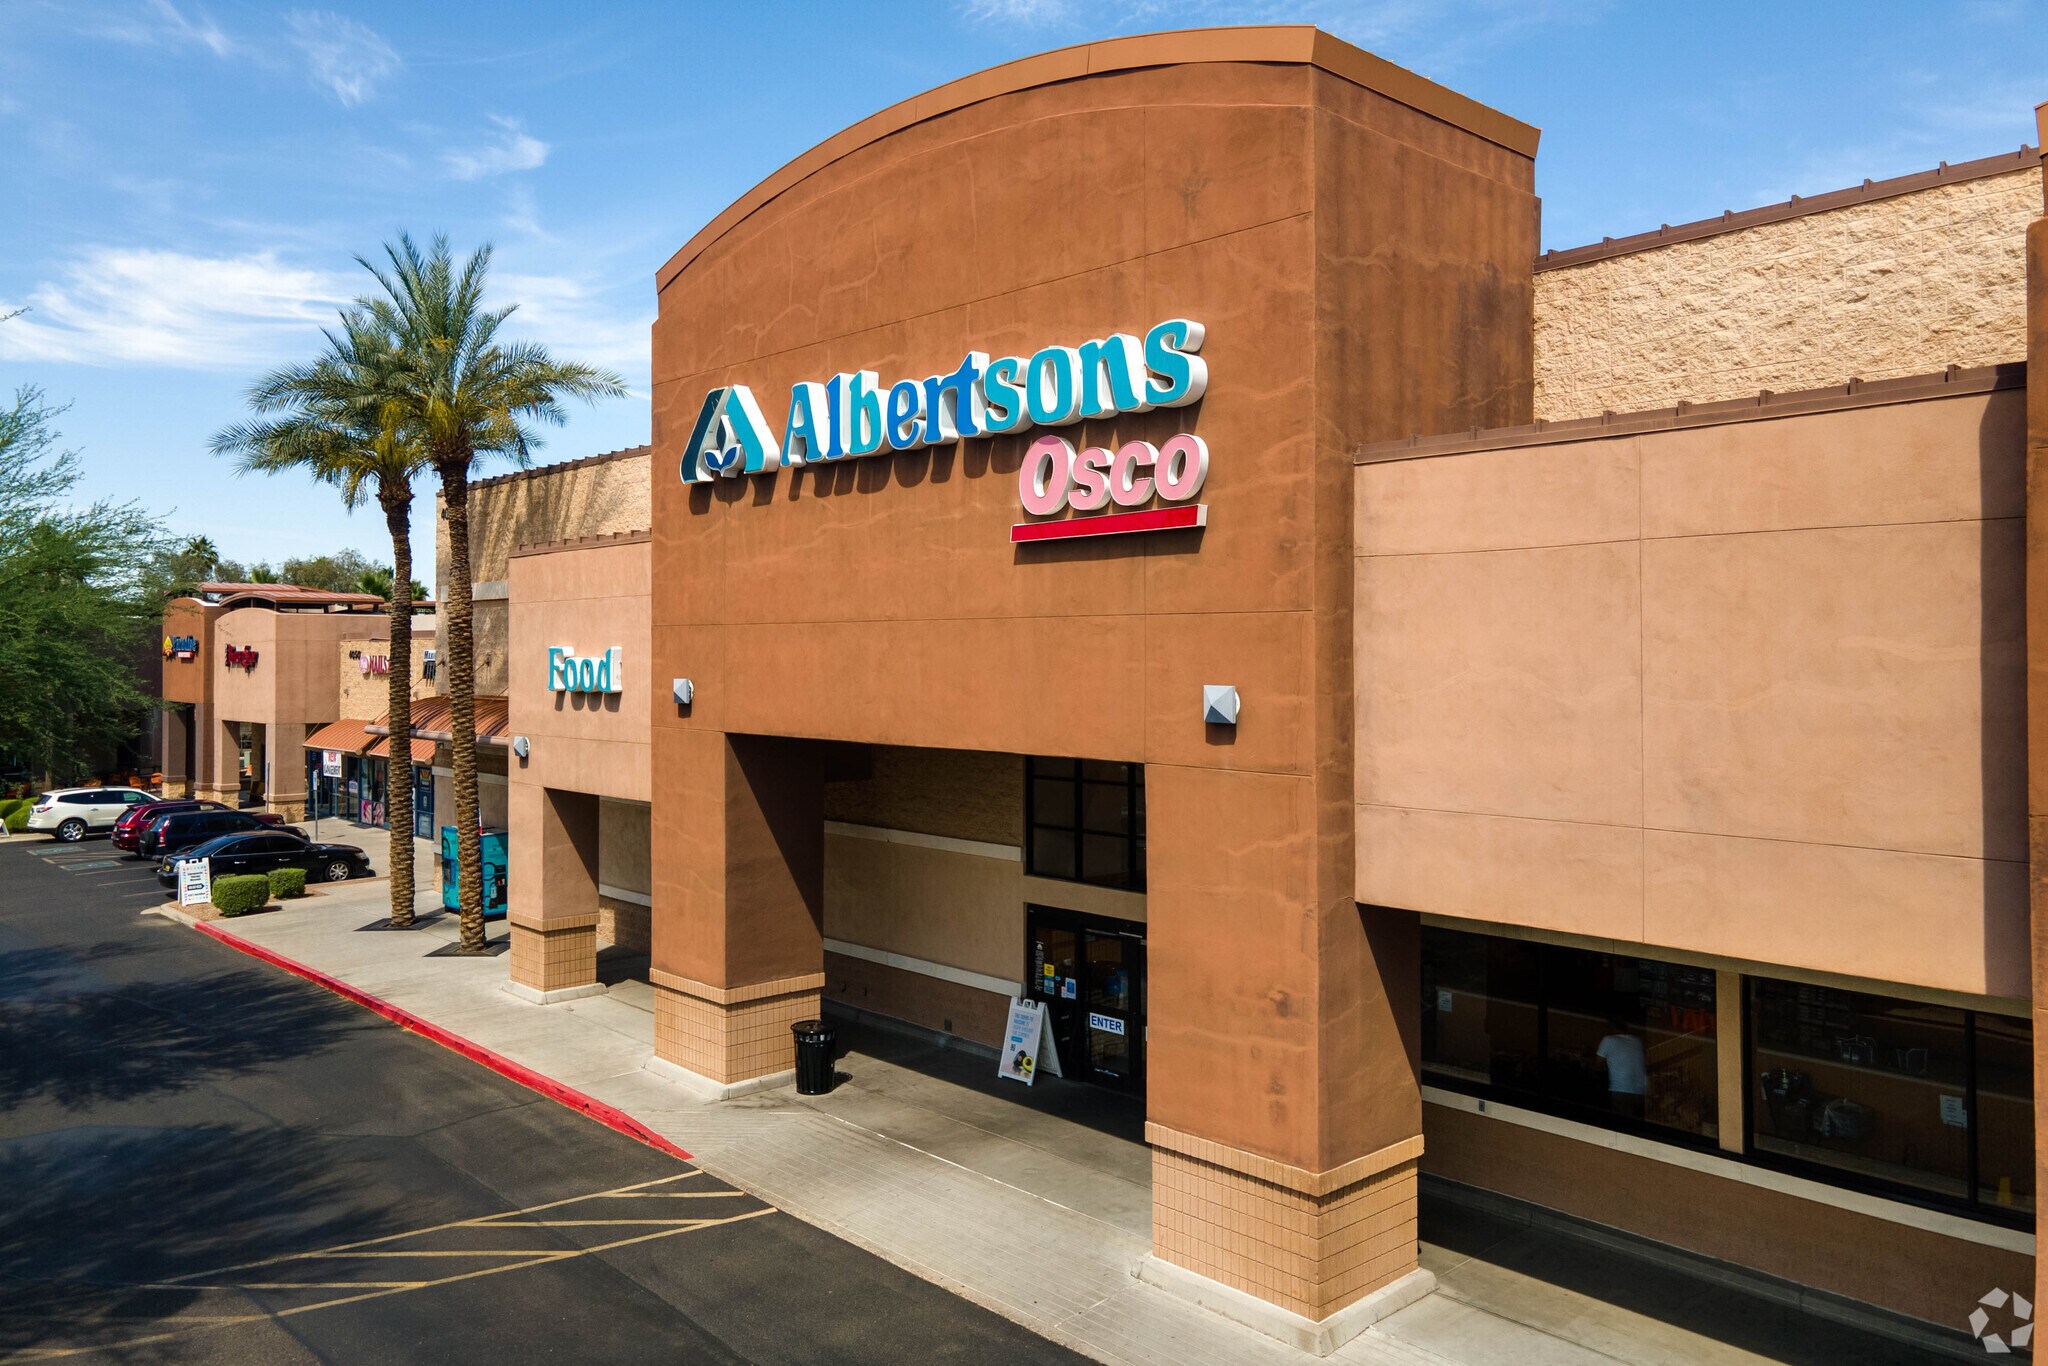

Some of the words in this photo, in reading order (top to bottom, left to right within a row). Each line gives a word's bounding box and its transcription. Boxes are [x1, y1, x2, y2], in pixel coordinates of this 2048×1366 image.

[780, 318, 1209, 467] Albertsons
[1017, 434, 1210, 516] Osco
[548, 645, 622, 693] Food
[1091, 1015, 1122, 1032] ENTER
